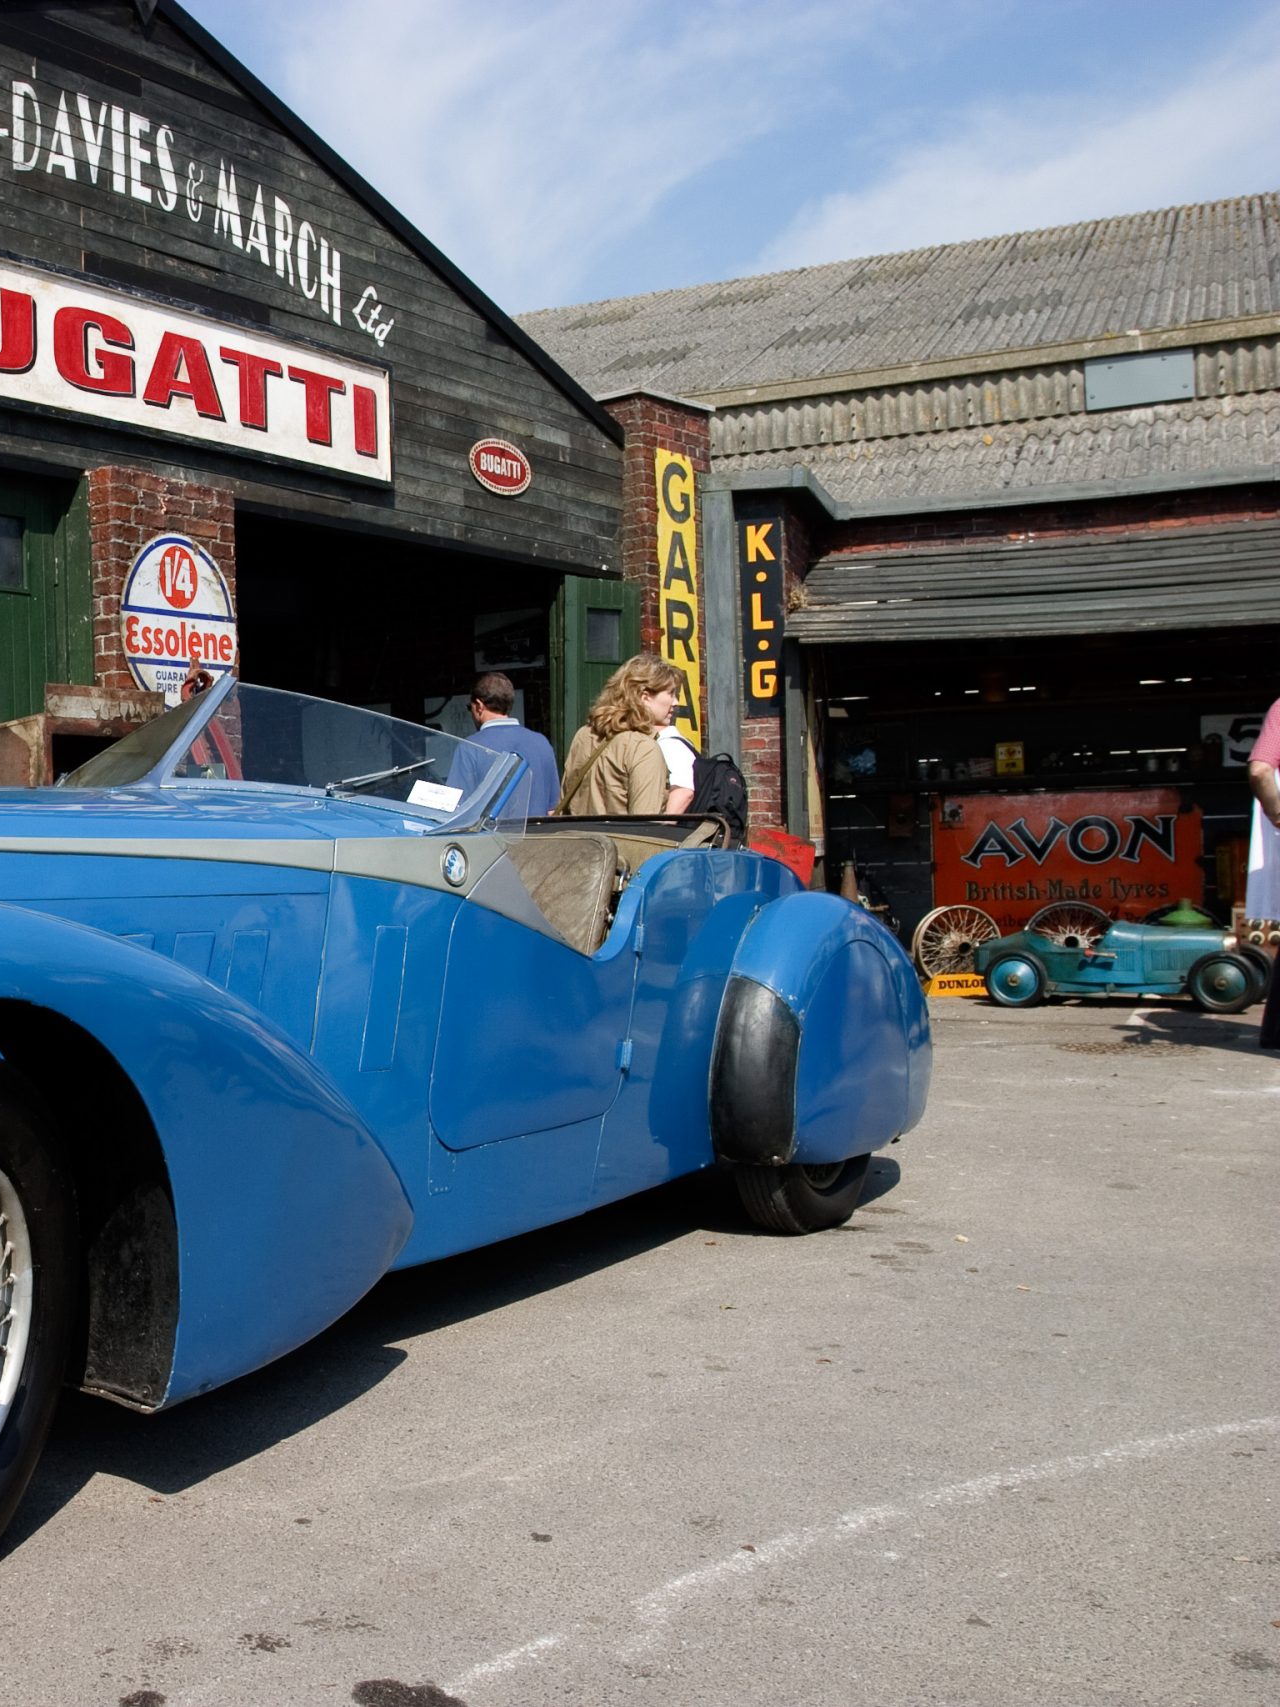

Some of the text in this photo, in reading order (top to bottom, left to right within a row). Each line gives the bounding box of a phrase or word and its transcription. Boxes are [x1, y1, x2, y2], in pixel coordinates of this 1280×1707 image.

[186, 162, 204, 222] &
[214, 157, 342, 326] MARCH
[352, 285, 394, 348] Ltd
[480, 452, 521, 480] BUGATTI
[125, 616, 233, 661] Essolene
[960, 814, 1178, 869] AVON
[1108, 878, 1169, 904] Tyres
[938, 979, 986, 989] DUNLO
